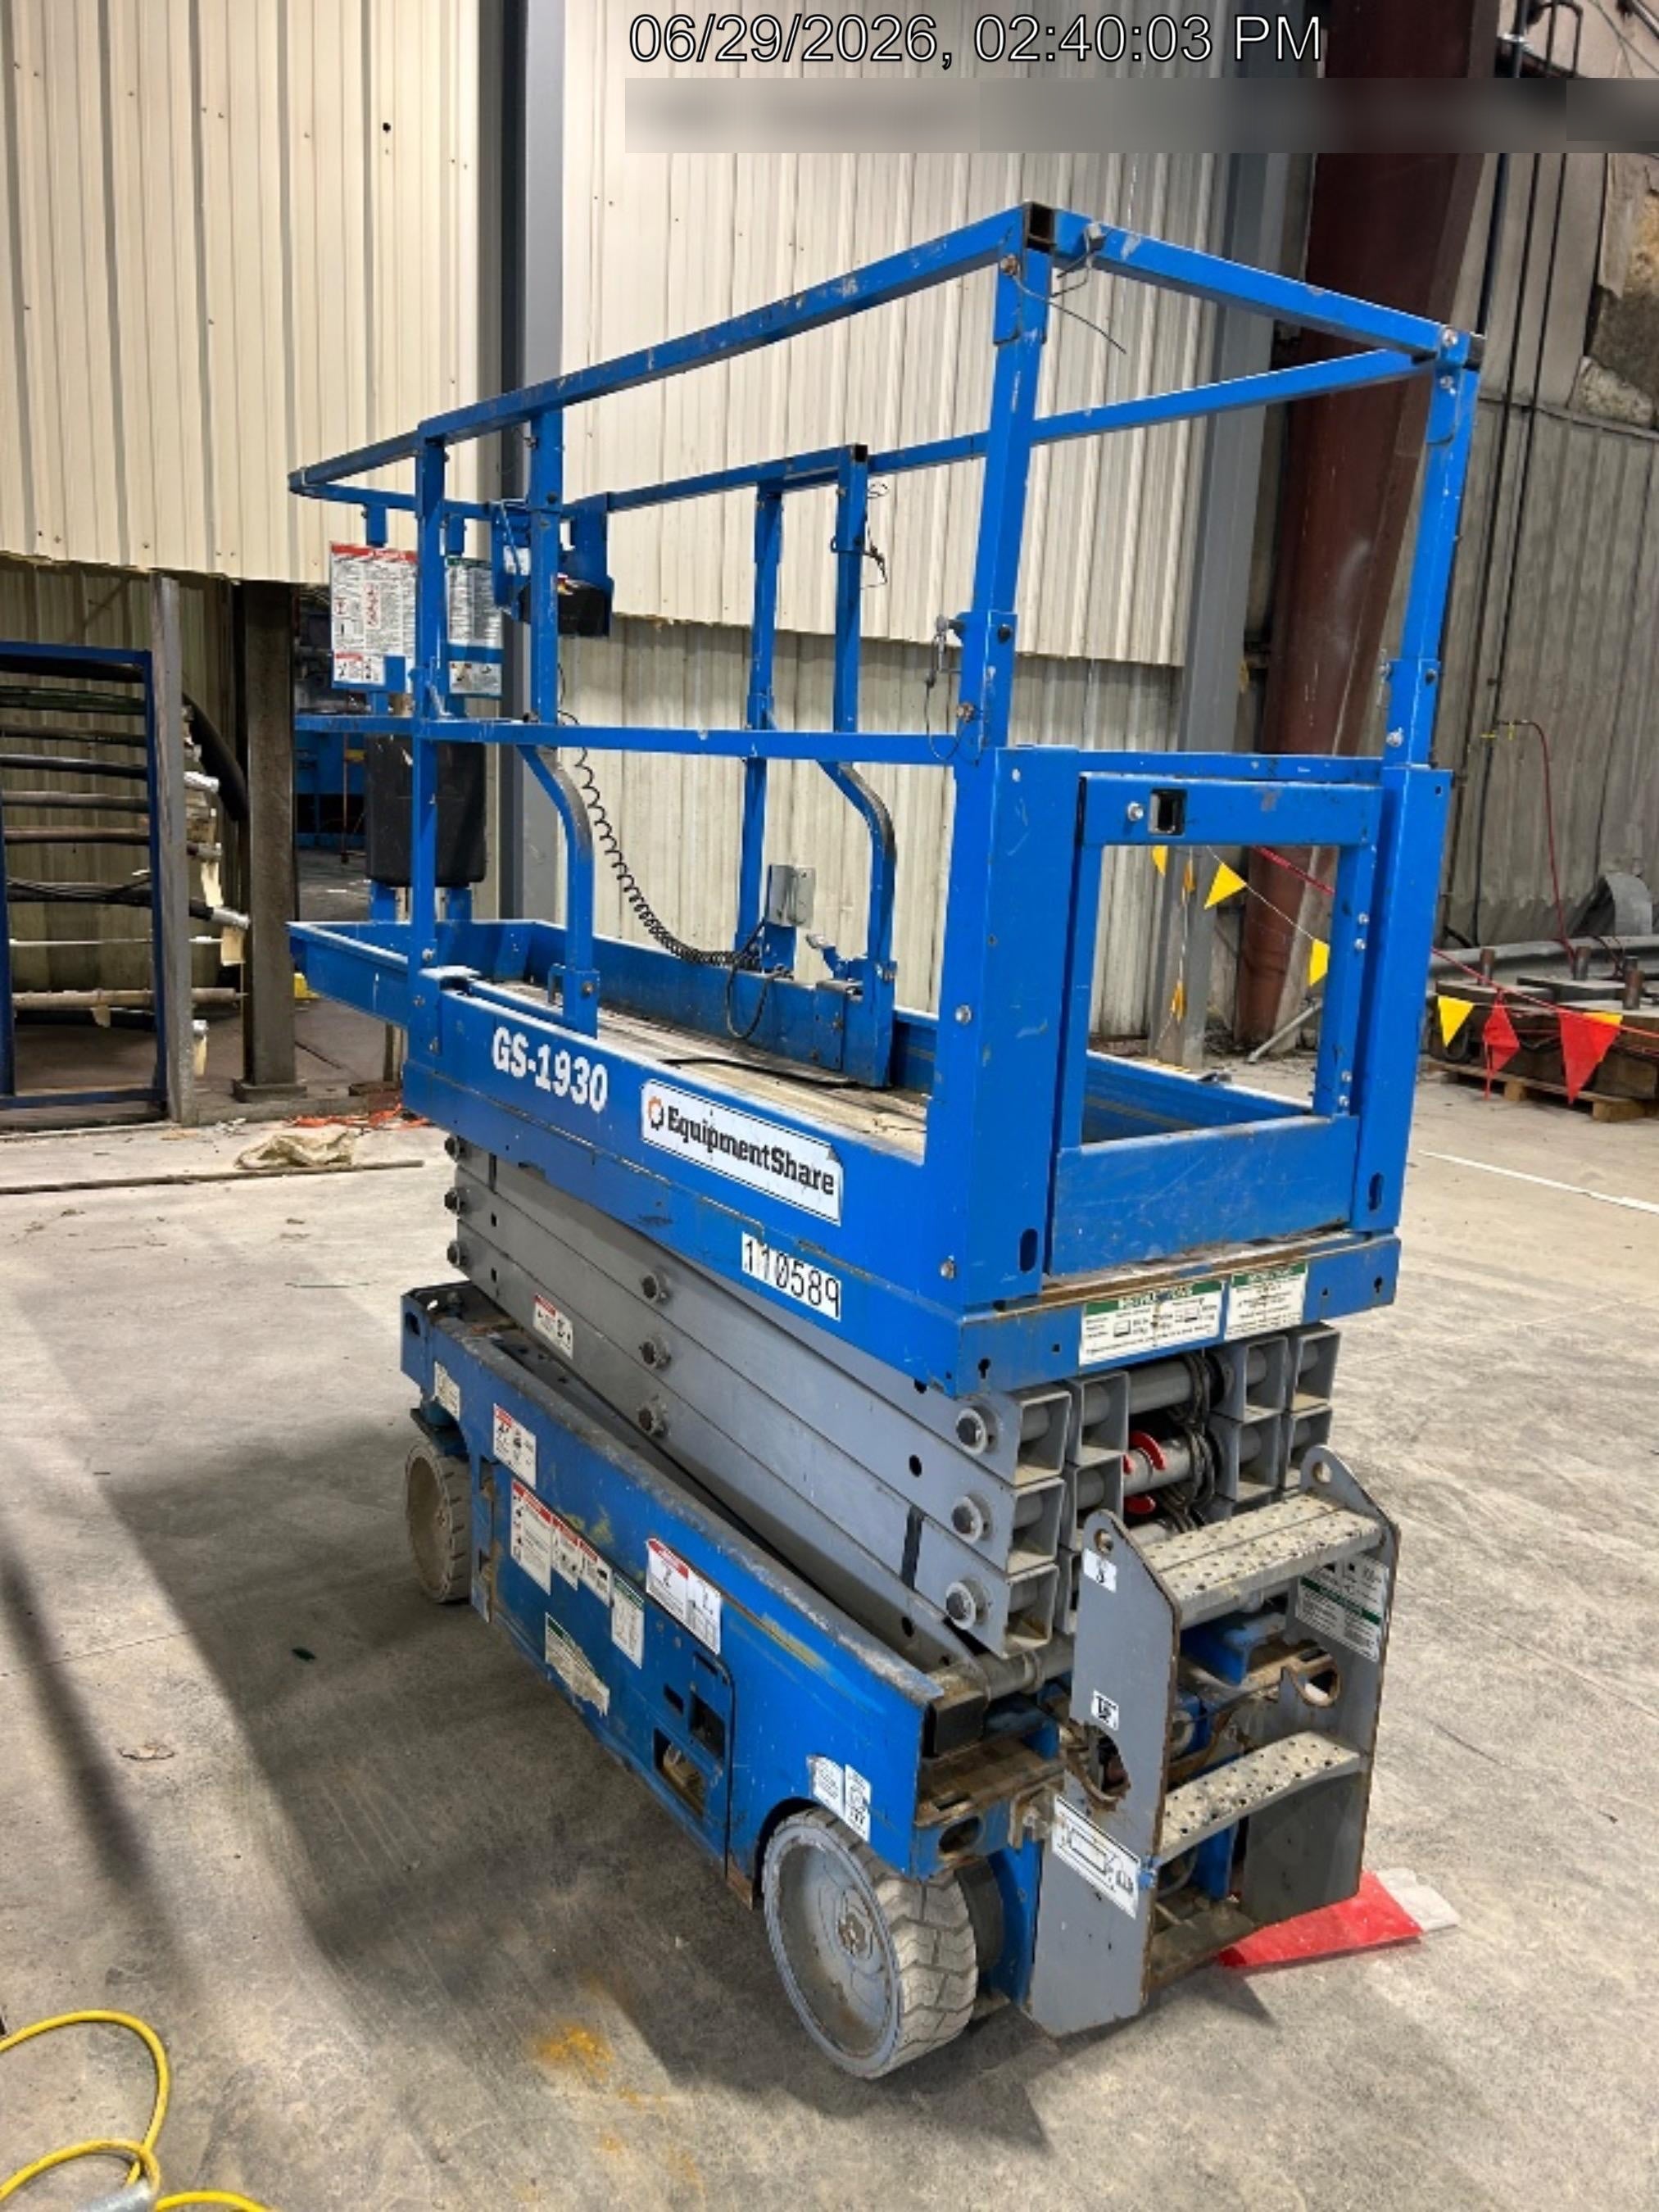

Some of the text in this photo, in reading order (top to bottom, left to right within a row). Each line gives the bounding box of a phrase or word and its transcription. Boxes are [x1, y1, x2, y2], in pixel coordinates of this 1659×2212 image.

[492, 1027, 608, 1113] GS-1930
[666, 1105, 835, 1195] EquipmentShare
[744, 1239, 841, 1318] 110589
